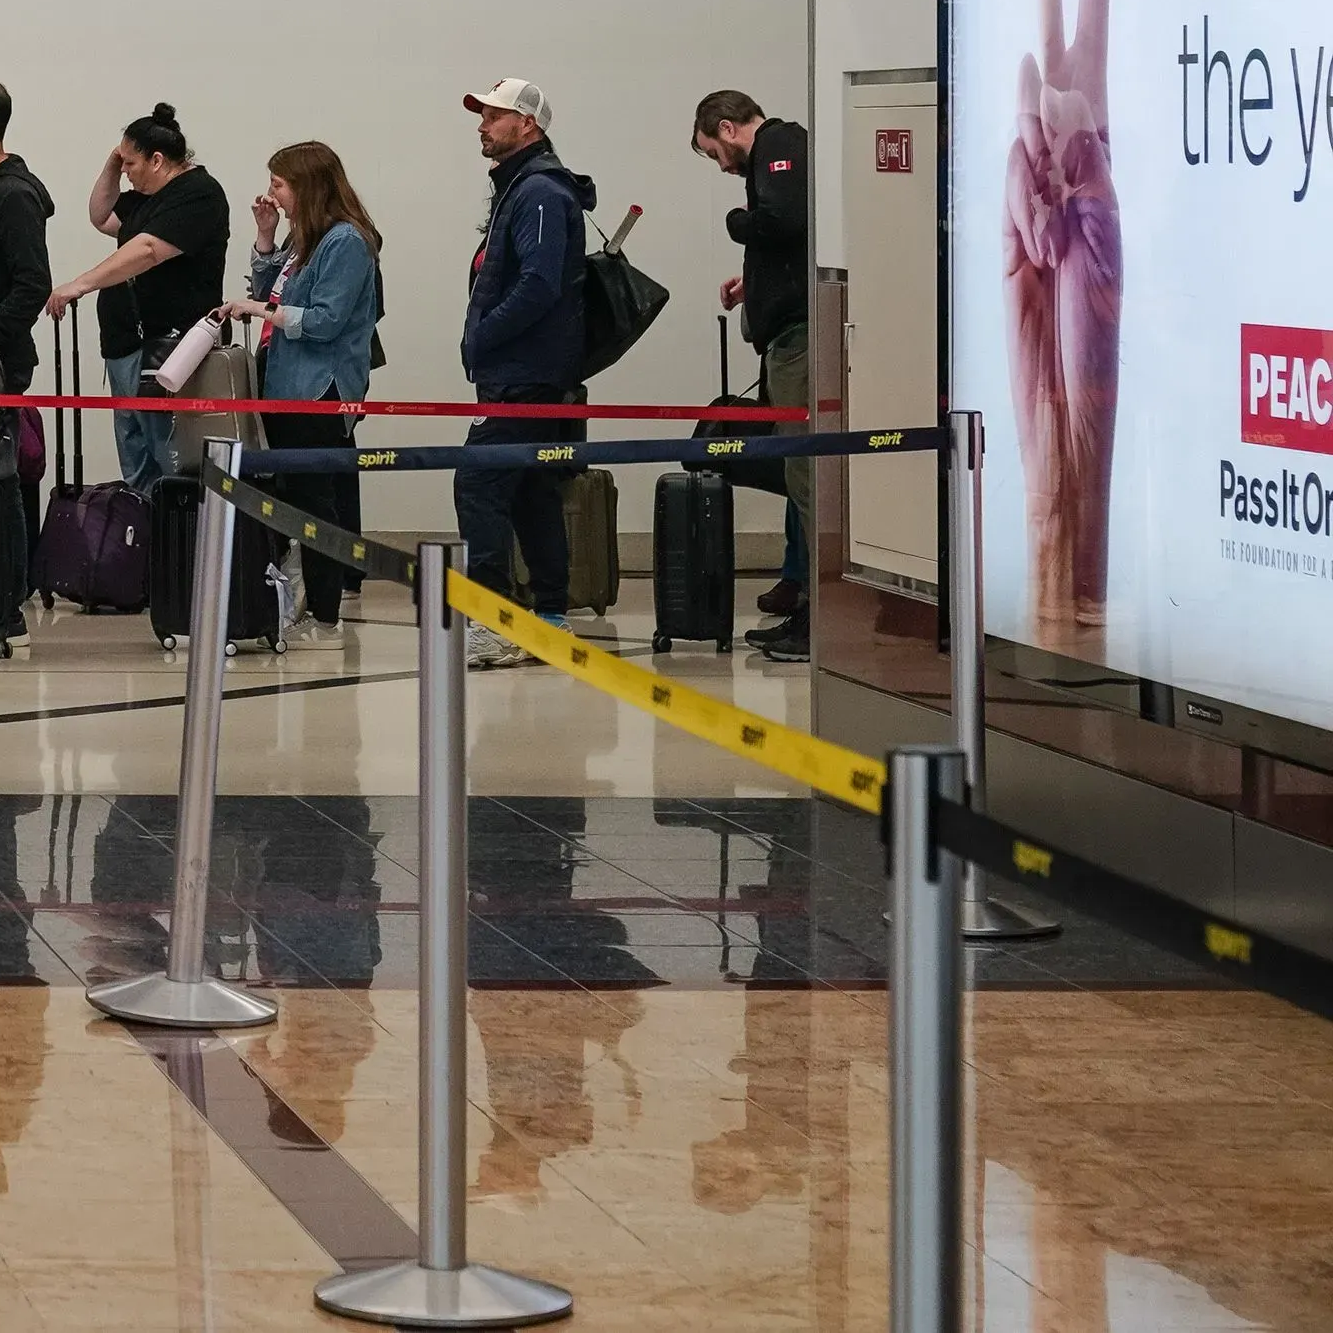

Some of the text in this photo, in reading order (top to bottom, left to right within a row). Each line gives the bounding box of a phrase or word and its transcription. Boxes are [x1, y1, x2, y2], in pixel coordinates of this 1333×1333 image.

[1178, 14, 1333, 203] the y
[337, 402, 367, 413] ATL
[869, 432, 905, 448] spirit
[537, 447, 575, 464] spirit
[707, 441, 745, 457] spirit
[357, 450, 398, 468] spirit
[1220, 538, 1236, 560] THE
[1240, 542, 1299, 573] FOUNDATION
